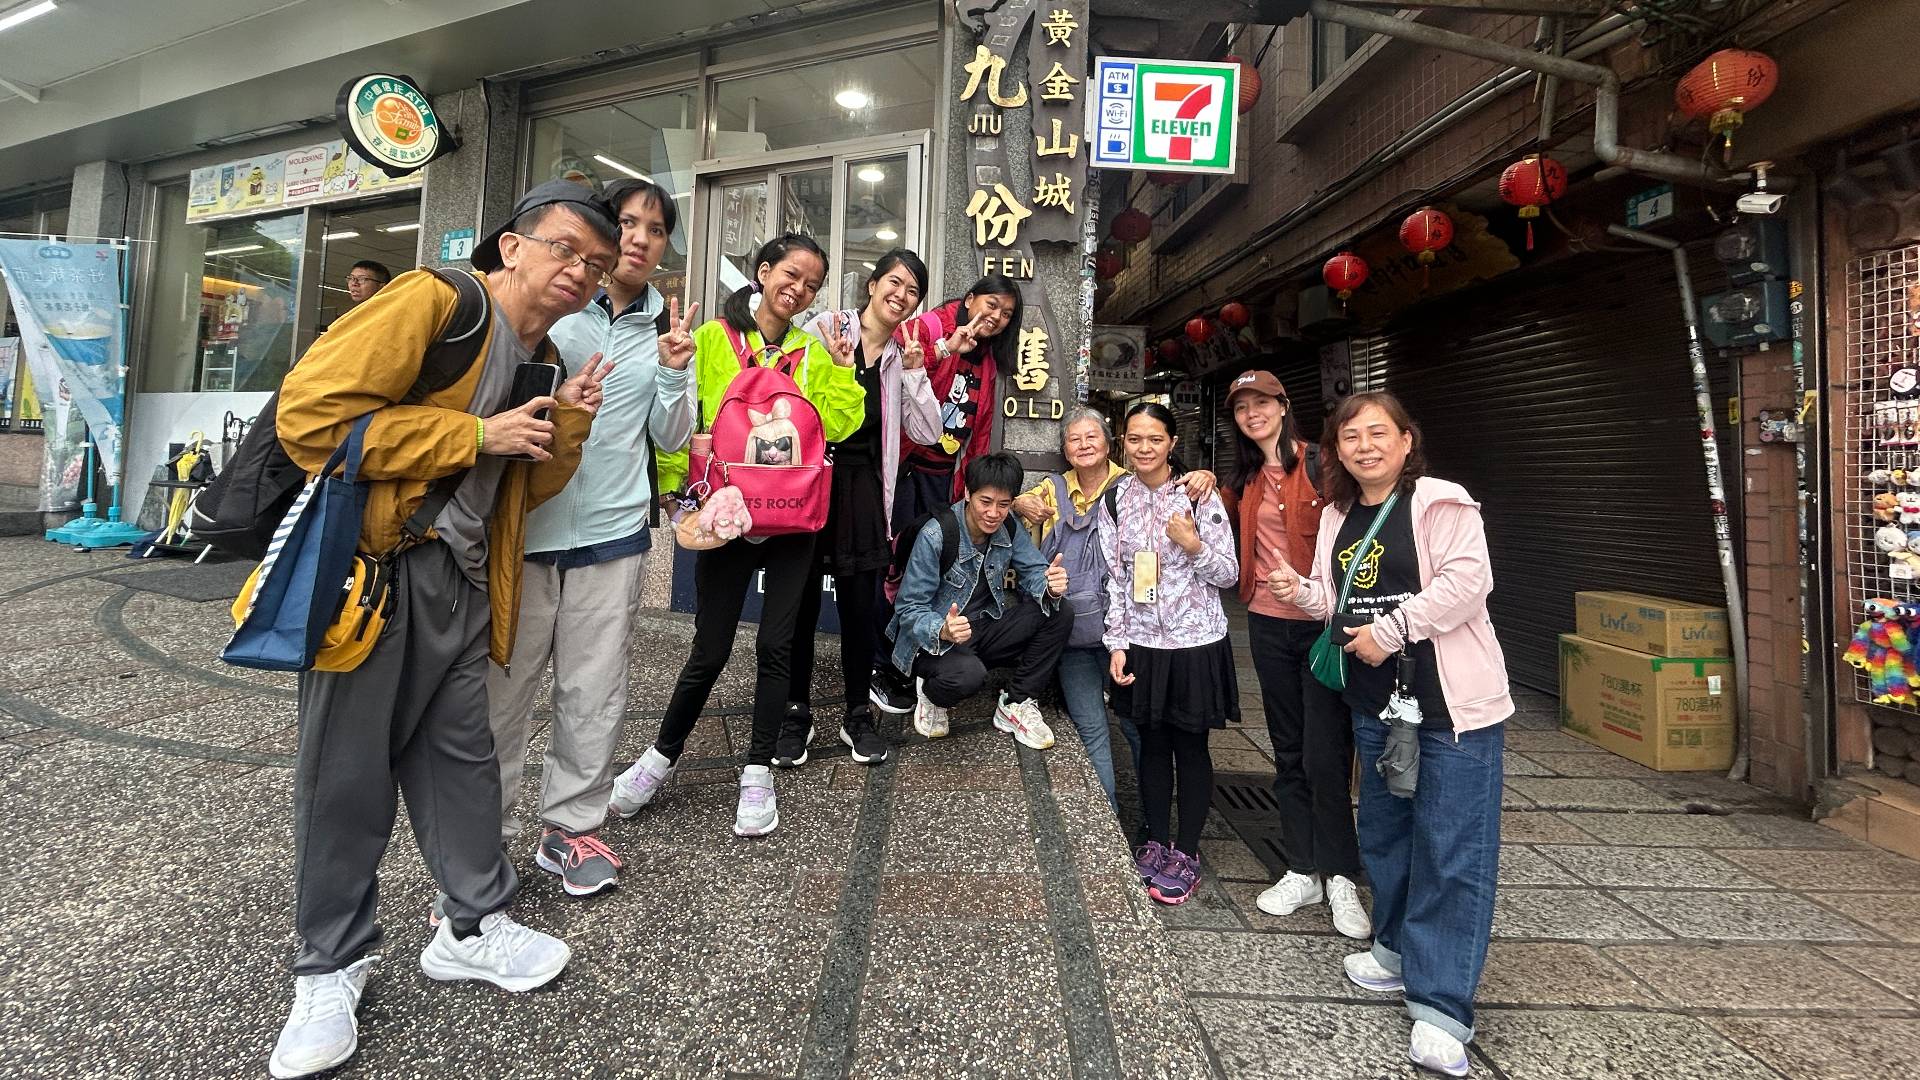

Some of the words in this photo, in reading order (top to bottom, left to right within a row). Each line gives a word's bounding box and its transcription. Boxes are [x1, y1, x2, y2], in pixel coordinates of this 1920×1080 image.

[1108, 71, 1129, 80] ATM
[404, 91, 430, 115] ATM
[1033, 8, 1079, 215] 黃金山城
[1106, 109, 1127, 118] Wi-Fi
[968, 113, 1002, 134] JIU
[288, 153, 324, 166] MOLESKINE
[966, 184, 1032, 247] 份
[1649, 199, 1659, 217] 4
[456, 241, 465, 257] 3
[983, 257, 1034, 279] FEN
[1003, 397, 1064, 419] OLD
[767, 498, 804, 509] ROCK
